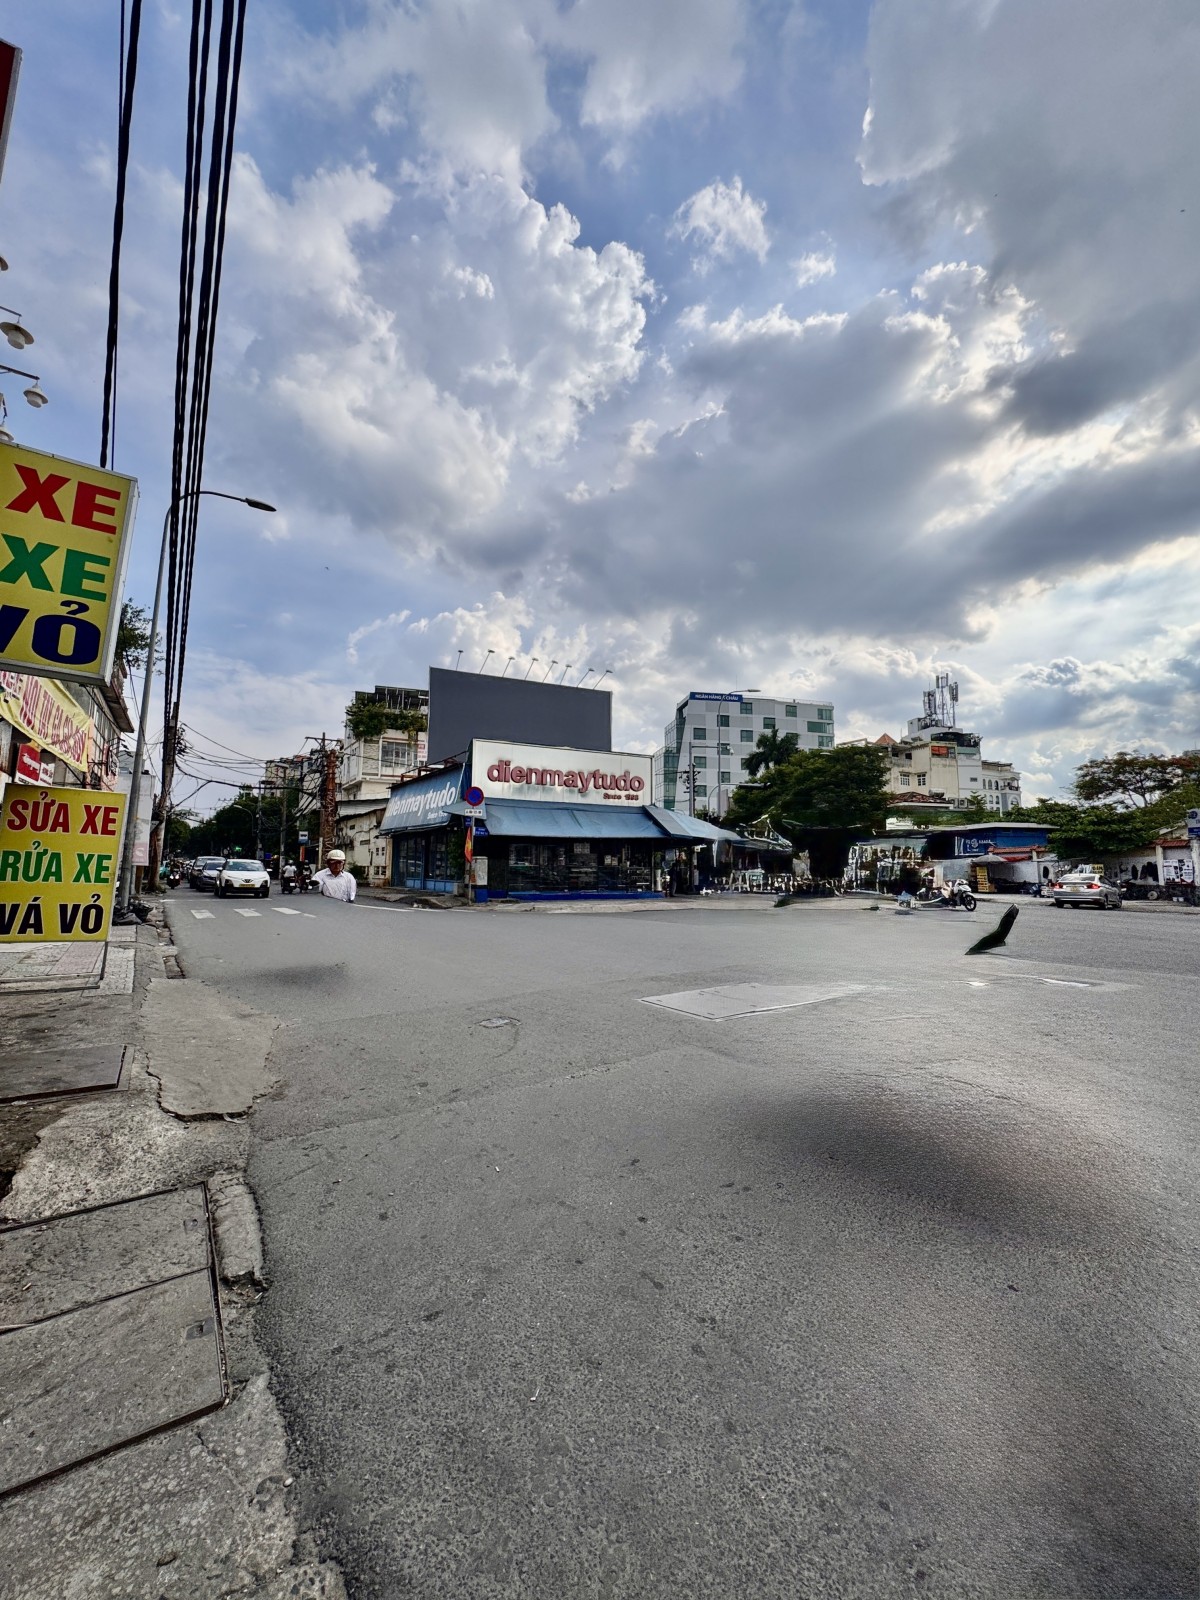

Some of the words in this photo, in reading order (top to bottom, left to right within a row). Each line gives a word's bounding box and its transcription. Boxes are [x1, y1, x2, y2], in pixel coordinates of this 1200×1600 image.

[5, 463, 121, 535] XE
[0, 533, 111, 602] XE
[487, 760, 645, 792] dienmaytudo
[7, 791, 70, 833] SỬA
[80, 804, 119, 836] XE
[0, 840, 63, 883] RỬA
[72, 853, 113, 884] XE
[0, 896, 44, 935] VÁ
[59, 893, 104, 935] VỎ
